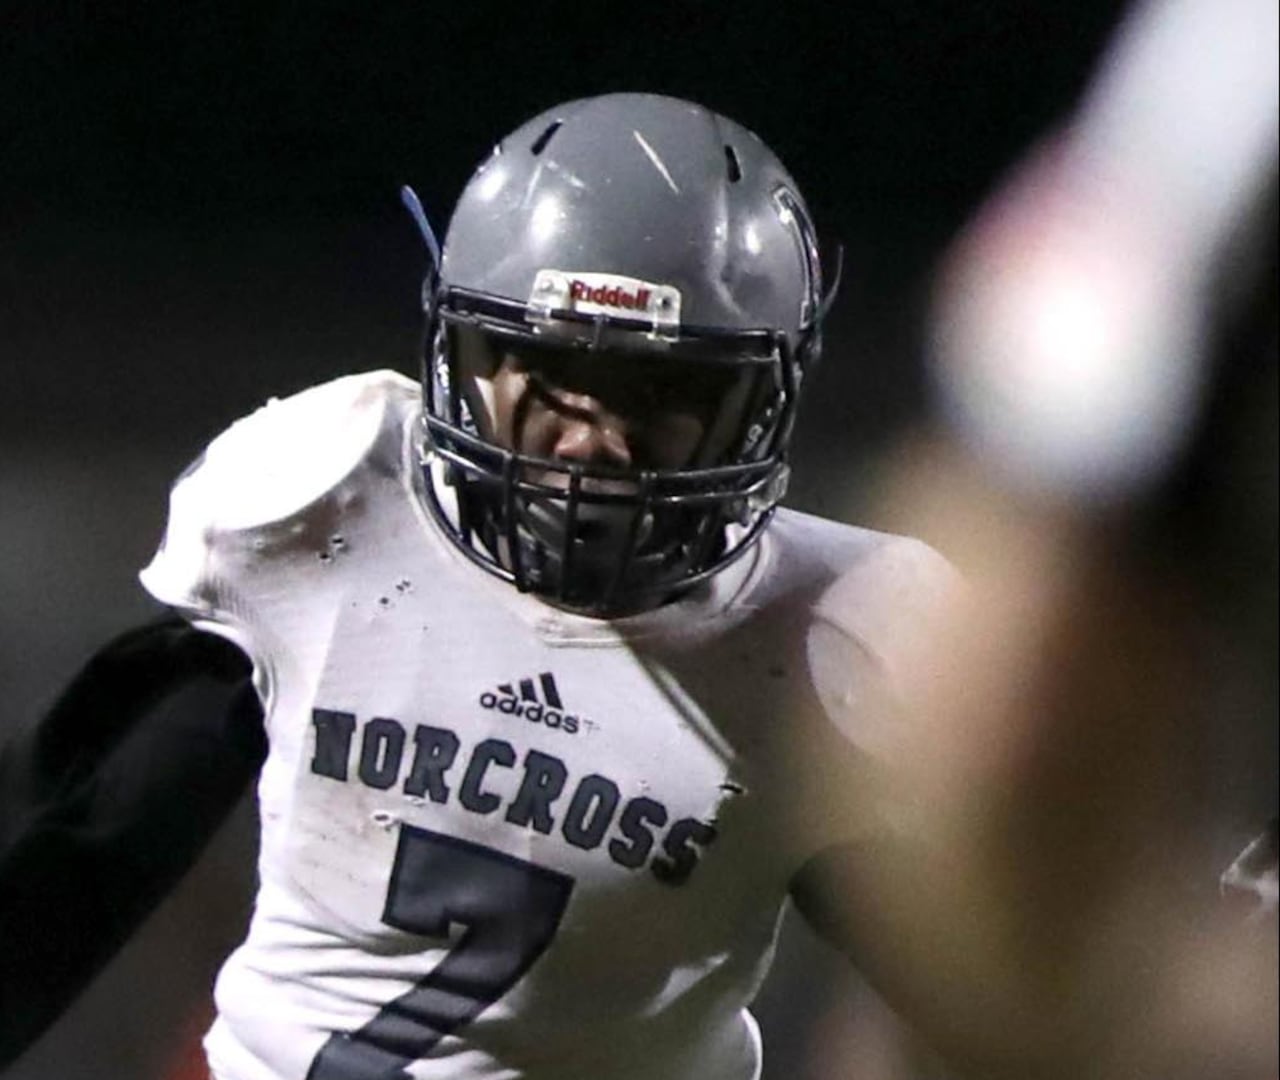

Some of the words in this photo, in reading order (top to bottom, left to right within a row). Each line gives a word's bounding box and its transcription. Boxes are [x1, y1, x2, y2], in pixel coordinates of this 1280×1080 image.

[570, 280, 652, 310] Riddell
[479, 692, 579, 734] adidas
[311, 707, 718, 887] NORCROSS
